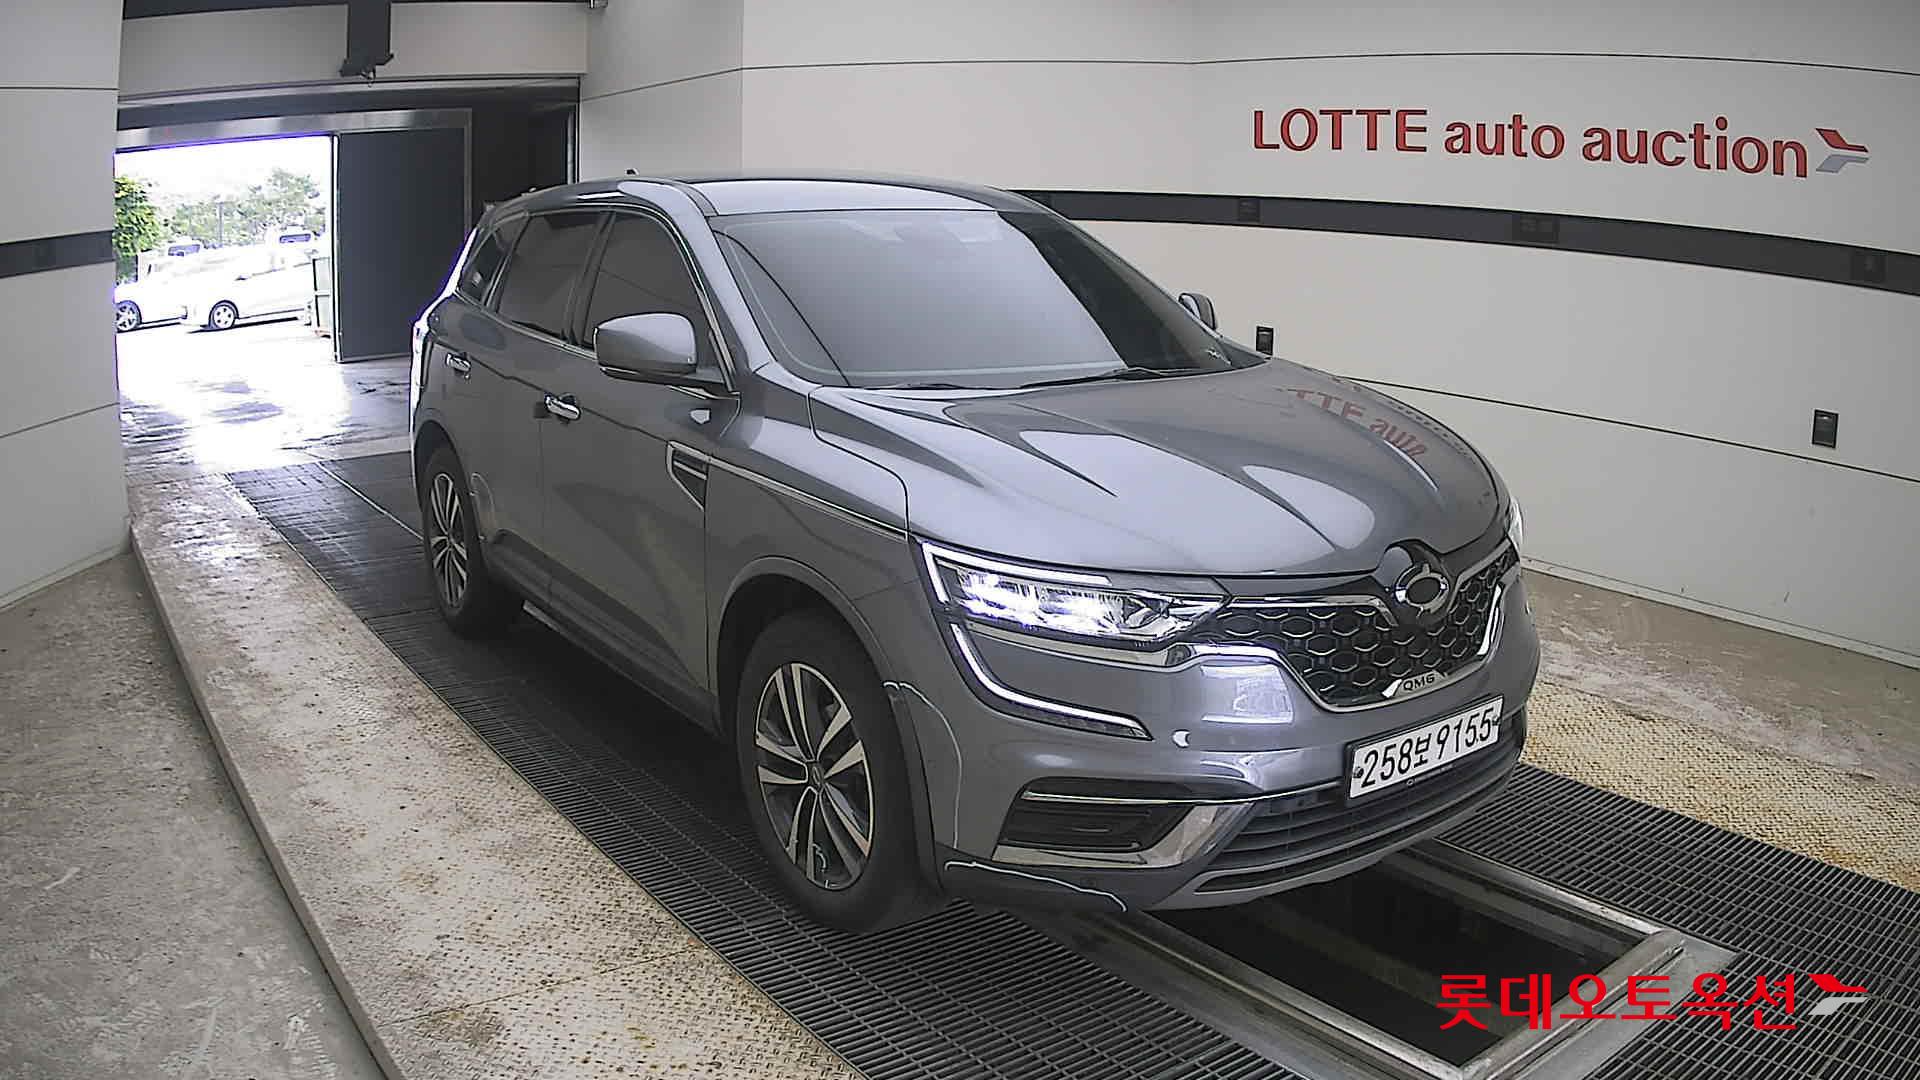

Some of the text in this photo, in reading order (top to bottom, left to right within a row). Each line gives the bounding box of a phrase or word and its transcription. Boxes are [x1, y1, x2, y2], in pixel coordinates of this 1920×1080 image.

[1253, 108, 1808, 178] LOTTE auto auction
